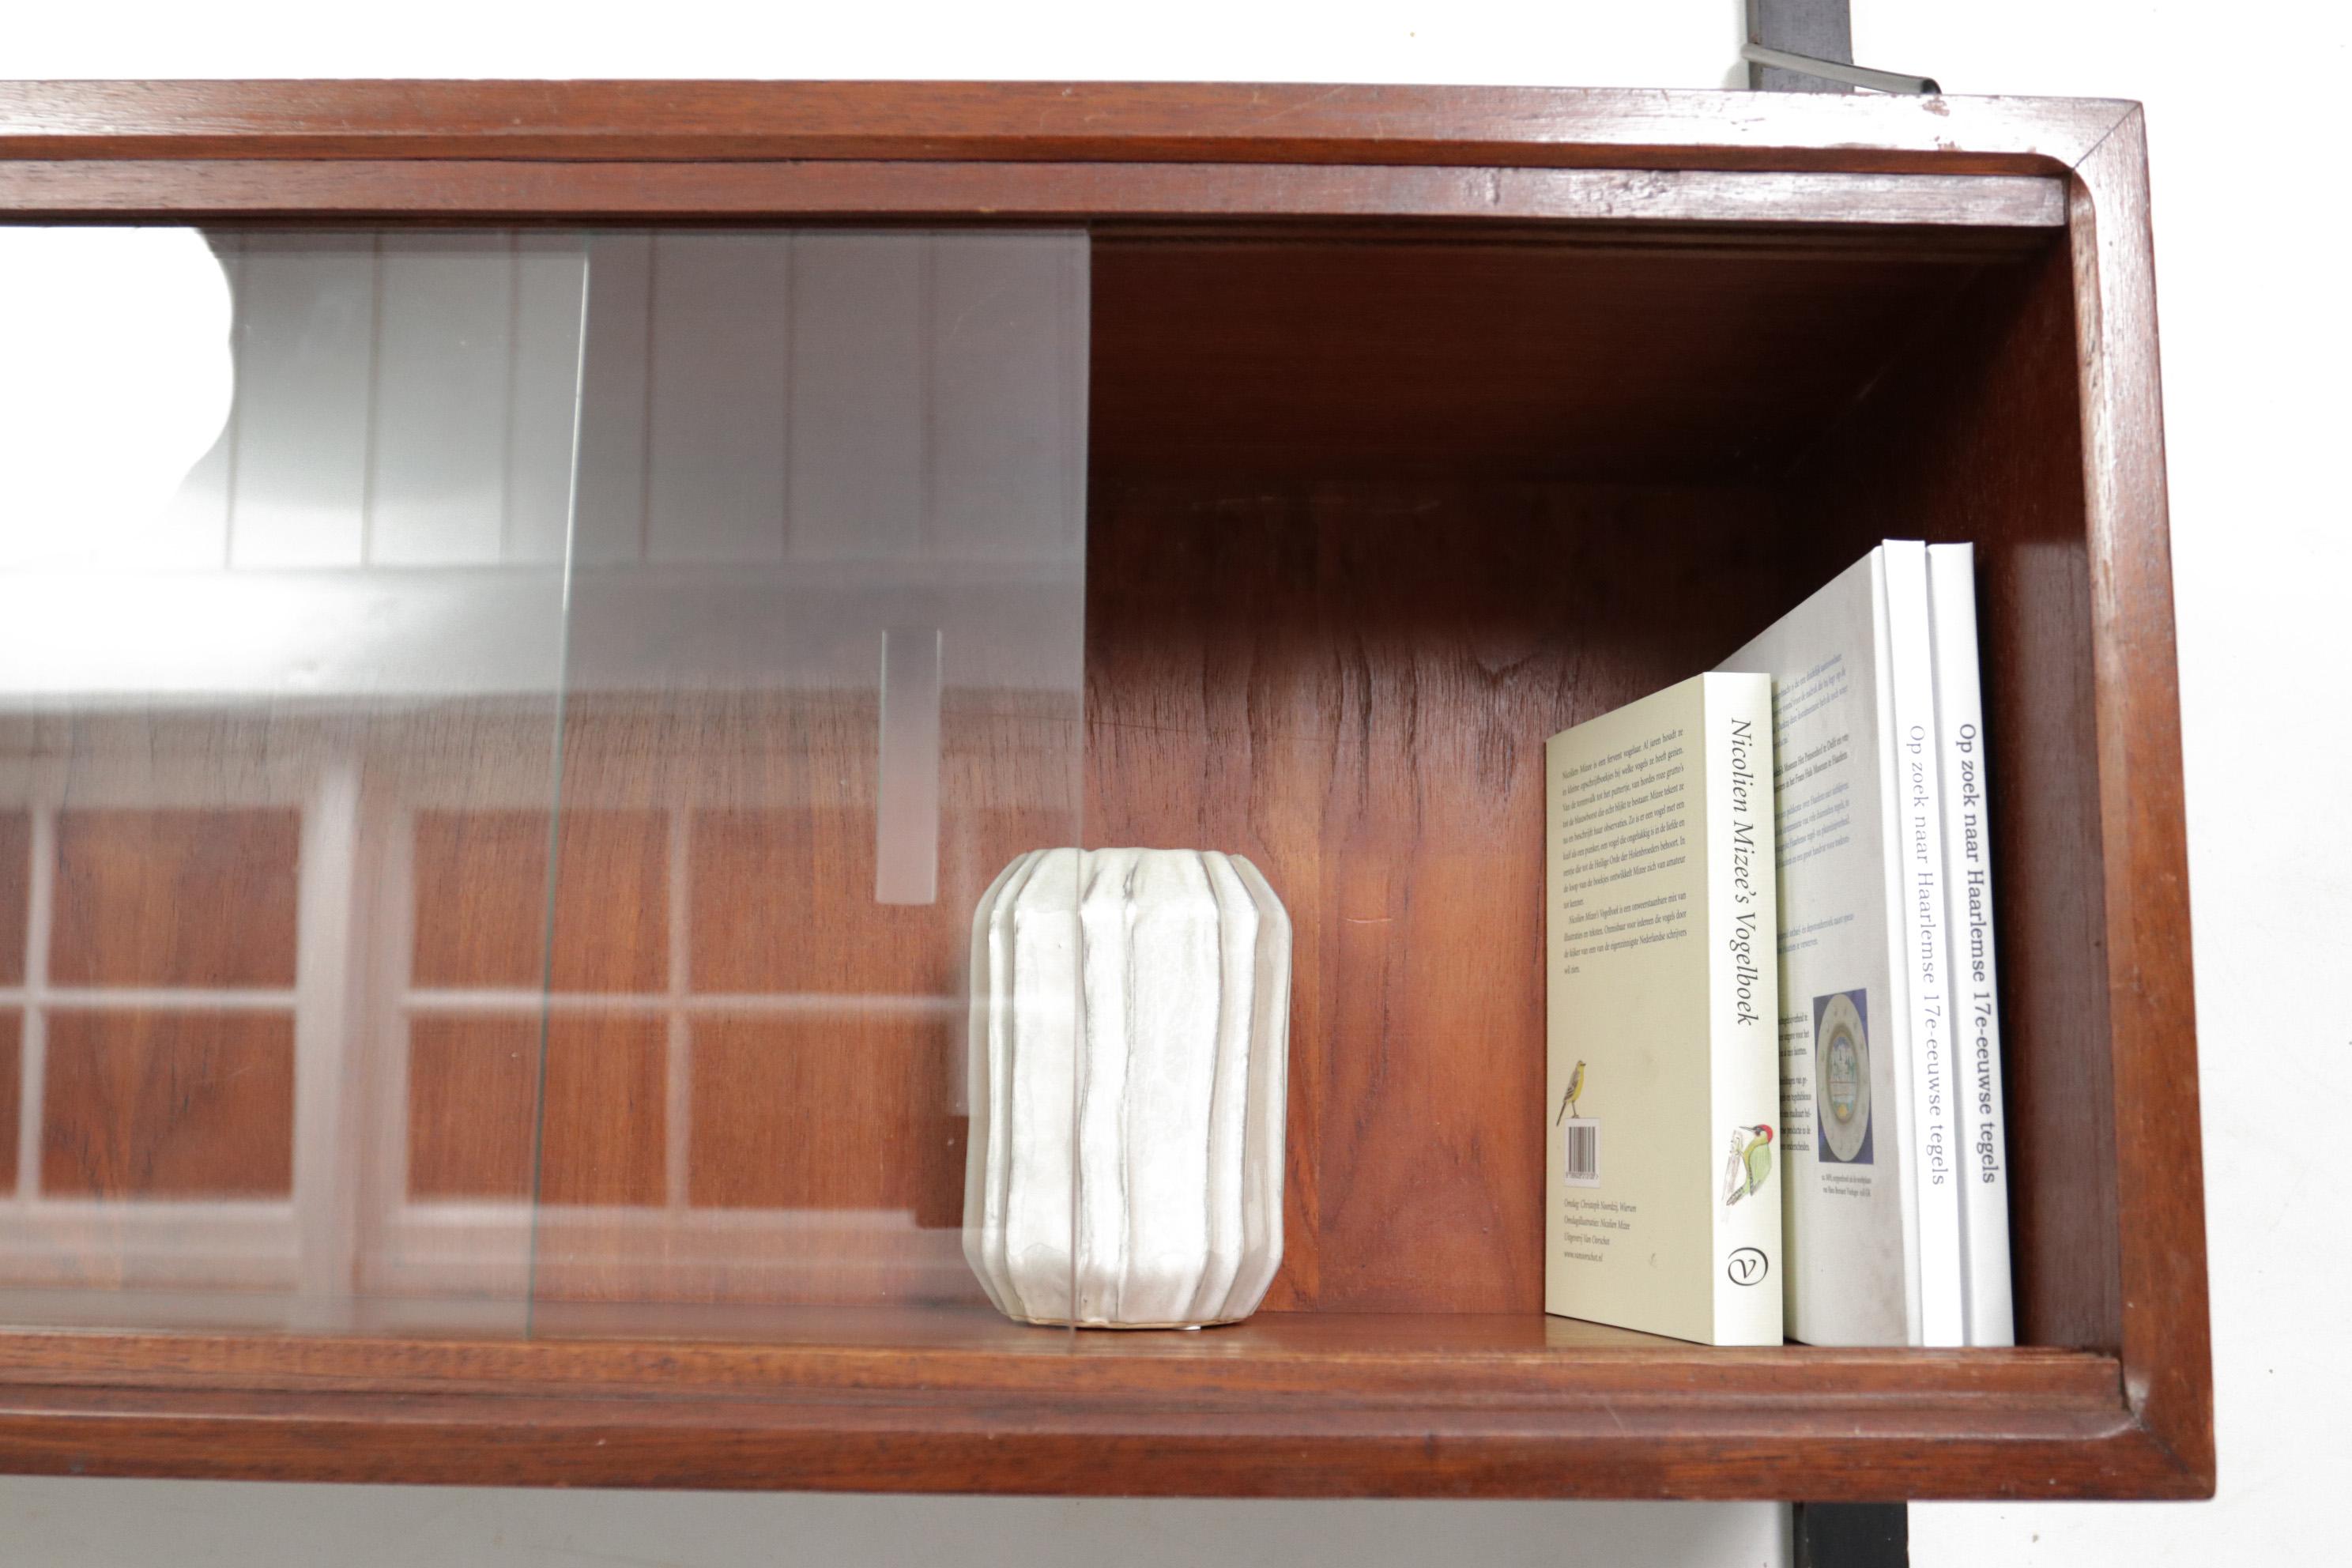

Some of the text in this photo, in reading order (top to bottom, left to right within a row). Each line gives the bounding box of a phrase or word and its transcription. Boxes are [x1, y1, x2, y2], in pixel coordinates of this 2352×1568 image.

[1729, 718, 1759, 1027] Nicolien Mizee's Vogelboek
[1905, 725, 1949, 1185] Op zoek naar Haarlemse 17e-eeuwse tegels
[1955, 723, 2000, 1184] Op zoek naar Haarlemse 17e-eeuwse tegels
